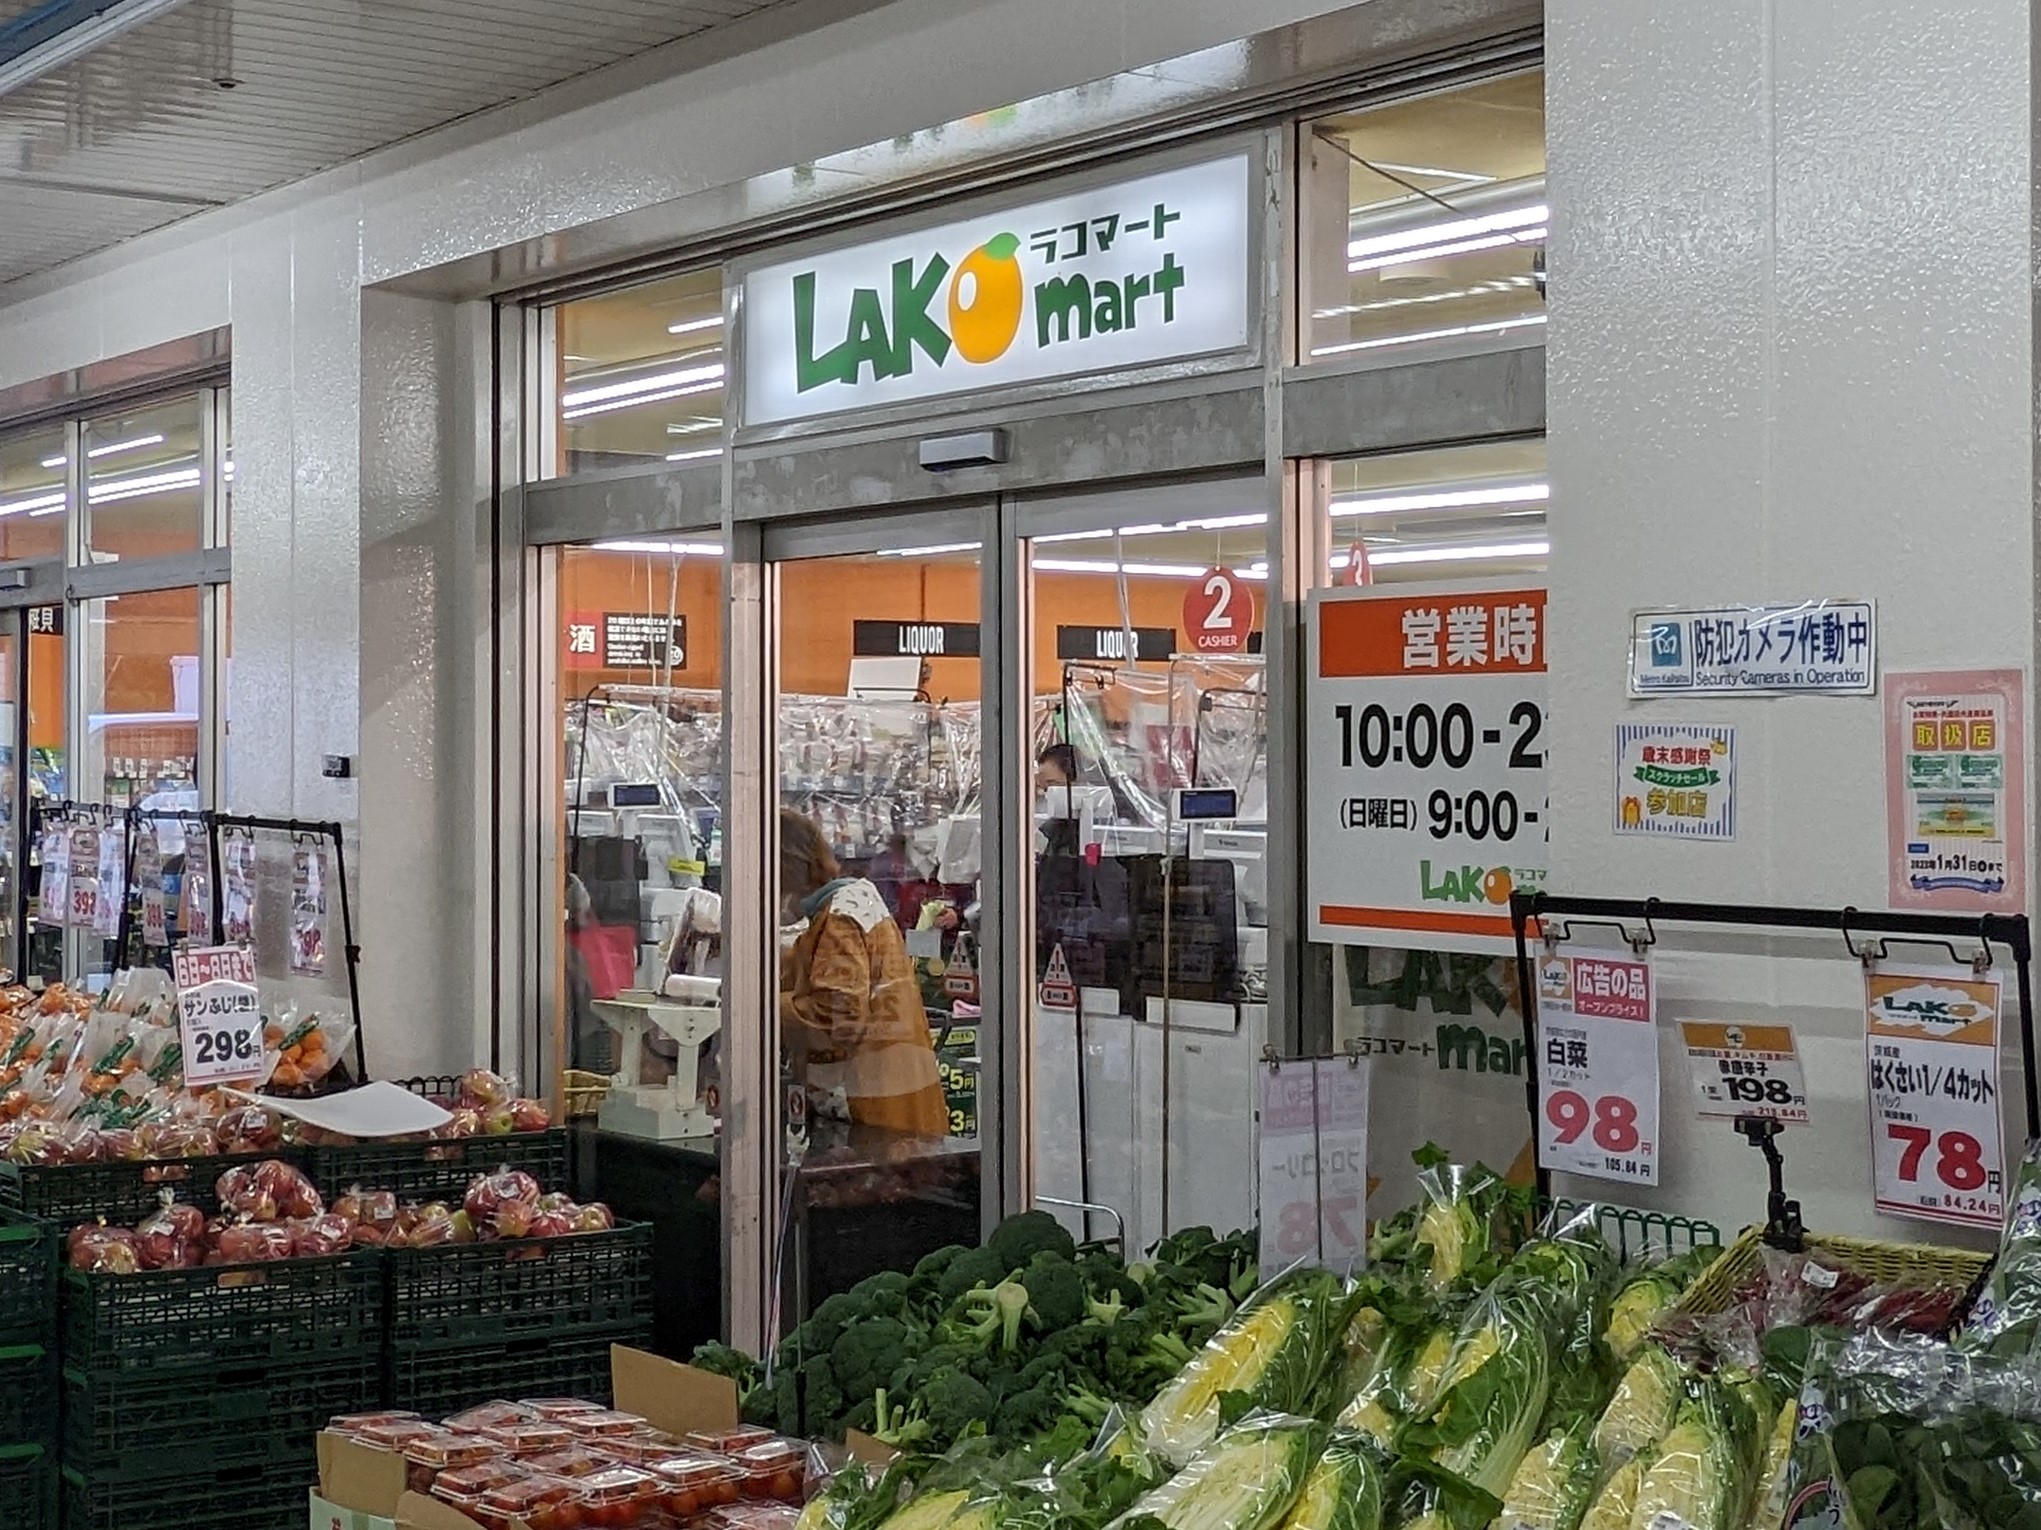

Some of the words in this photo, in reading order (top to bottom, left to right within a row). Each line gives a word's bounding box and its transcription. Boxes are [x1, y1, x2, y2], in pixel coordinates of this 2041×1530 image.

[1029, 202, 1181, 264] ラコマート
[1033, 252, 1186, 349] mart
[1203, 575, 1232, 629] 2
[569, 623, 596, 653] 酒
[898, 625, 945, 654] LIQUOR
[1198, 634, 1238, 648] CASHIER
[1402, 603, 1548, 668] 営業時
[1694, 612, 1868, 667] 防犯カメラ作動中
[1695, 672, 1738, 687] Security
[1741, 670, 1790, 685] Cameras
[1794, 669, 1804, 683] in
[1806, 667, 1865, 685] Operation
[1334, 701, 1548, 769] 10:00-2
[1916, 723, 1992, 748] 取扱店
[1646, 787, 1708, 818] 参加店
[1576, 962, 1647, 1002] 広告の品
[1547, 1038, 1588, 1069] 白菜
